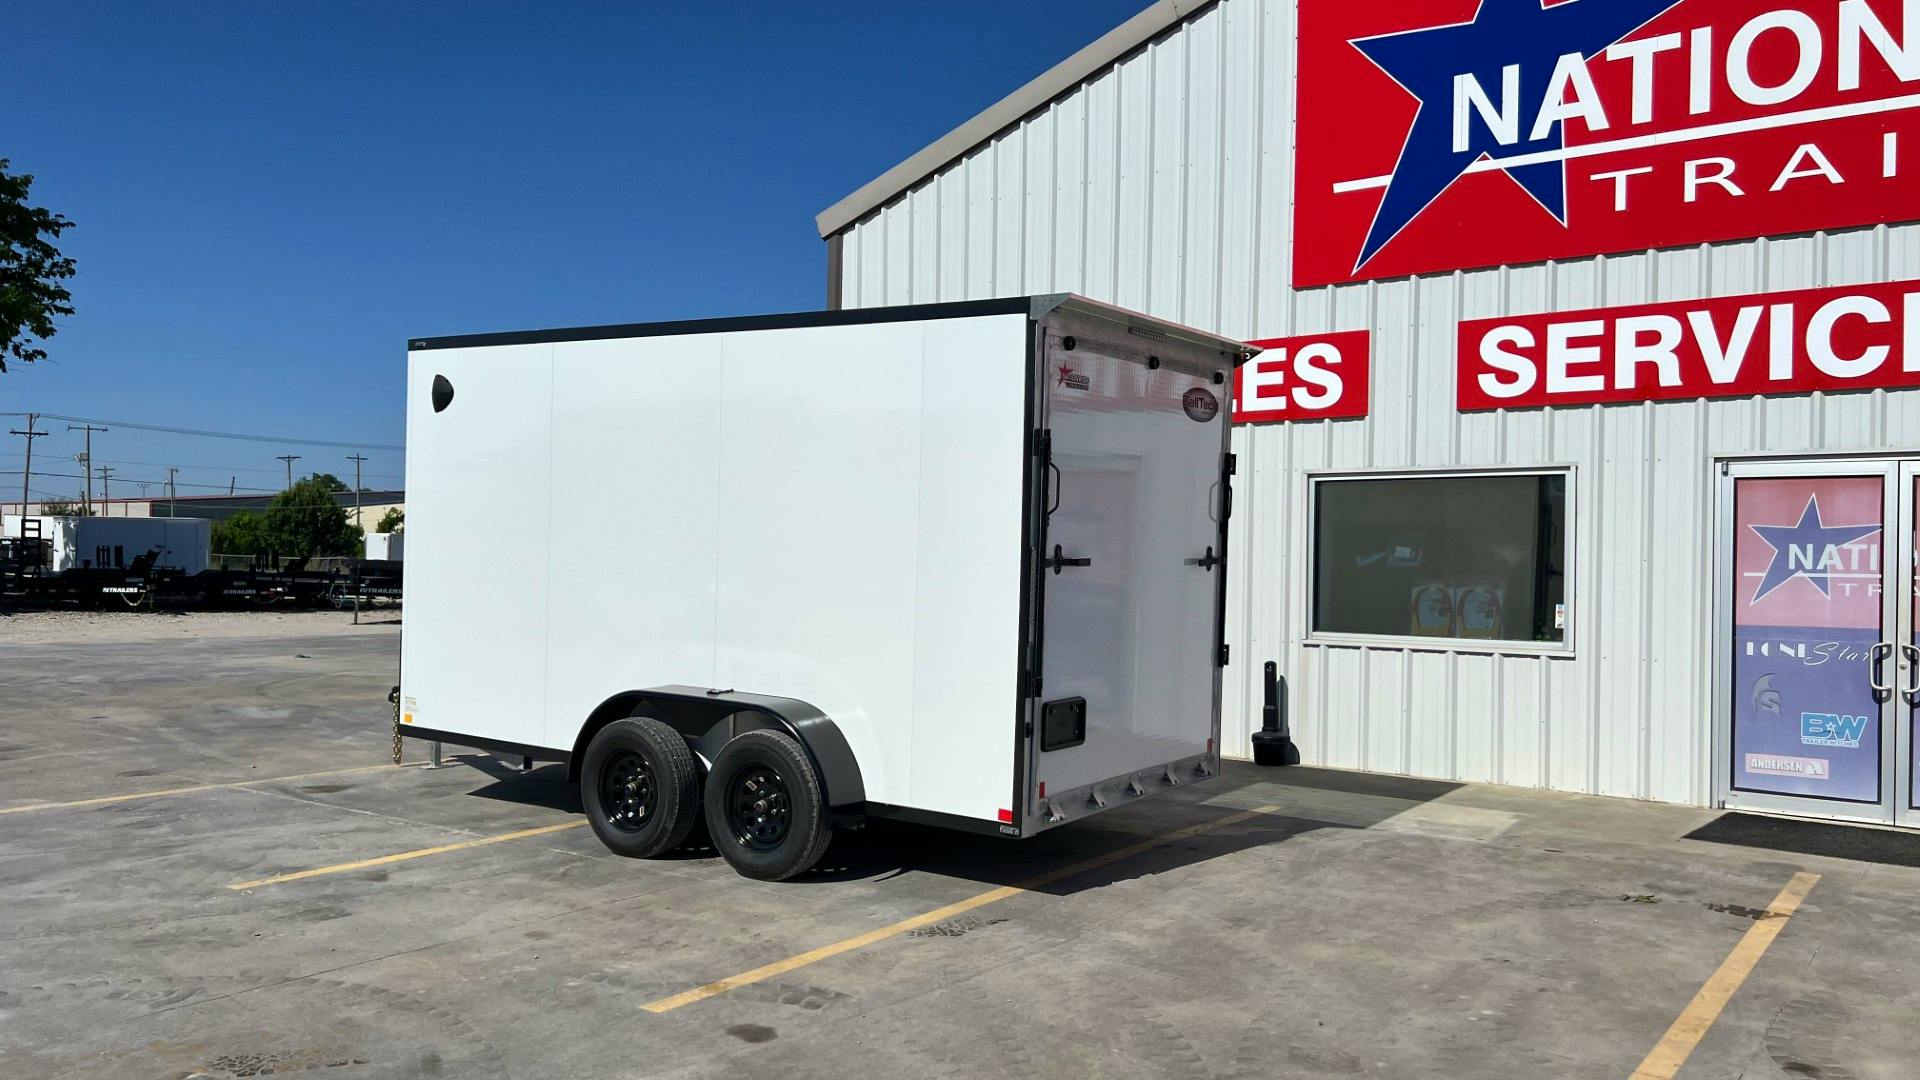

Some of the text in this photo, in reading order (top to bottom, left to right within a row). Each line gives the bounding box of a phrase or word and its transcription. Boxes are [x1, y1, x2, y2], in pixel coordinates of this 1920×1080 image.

[1590, 131, 1898, 212] TRAI
[1232, 342, 1344, 413] ES
[1788, 543, 1878, 571] NATI
[1750, 758, 1803, 772] ANDERSEN
